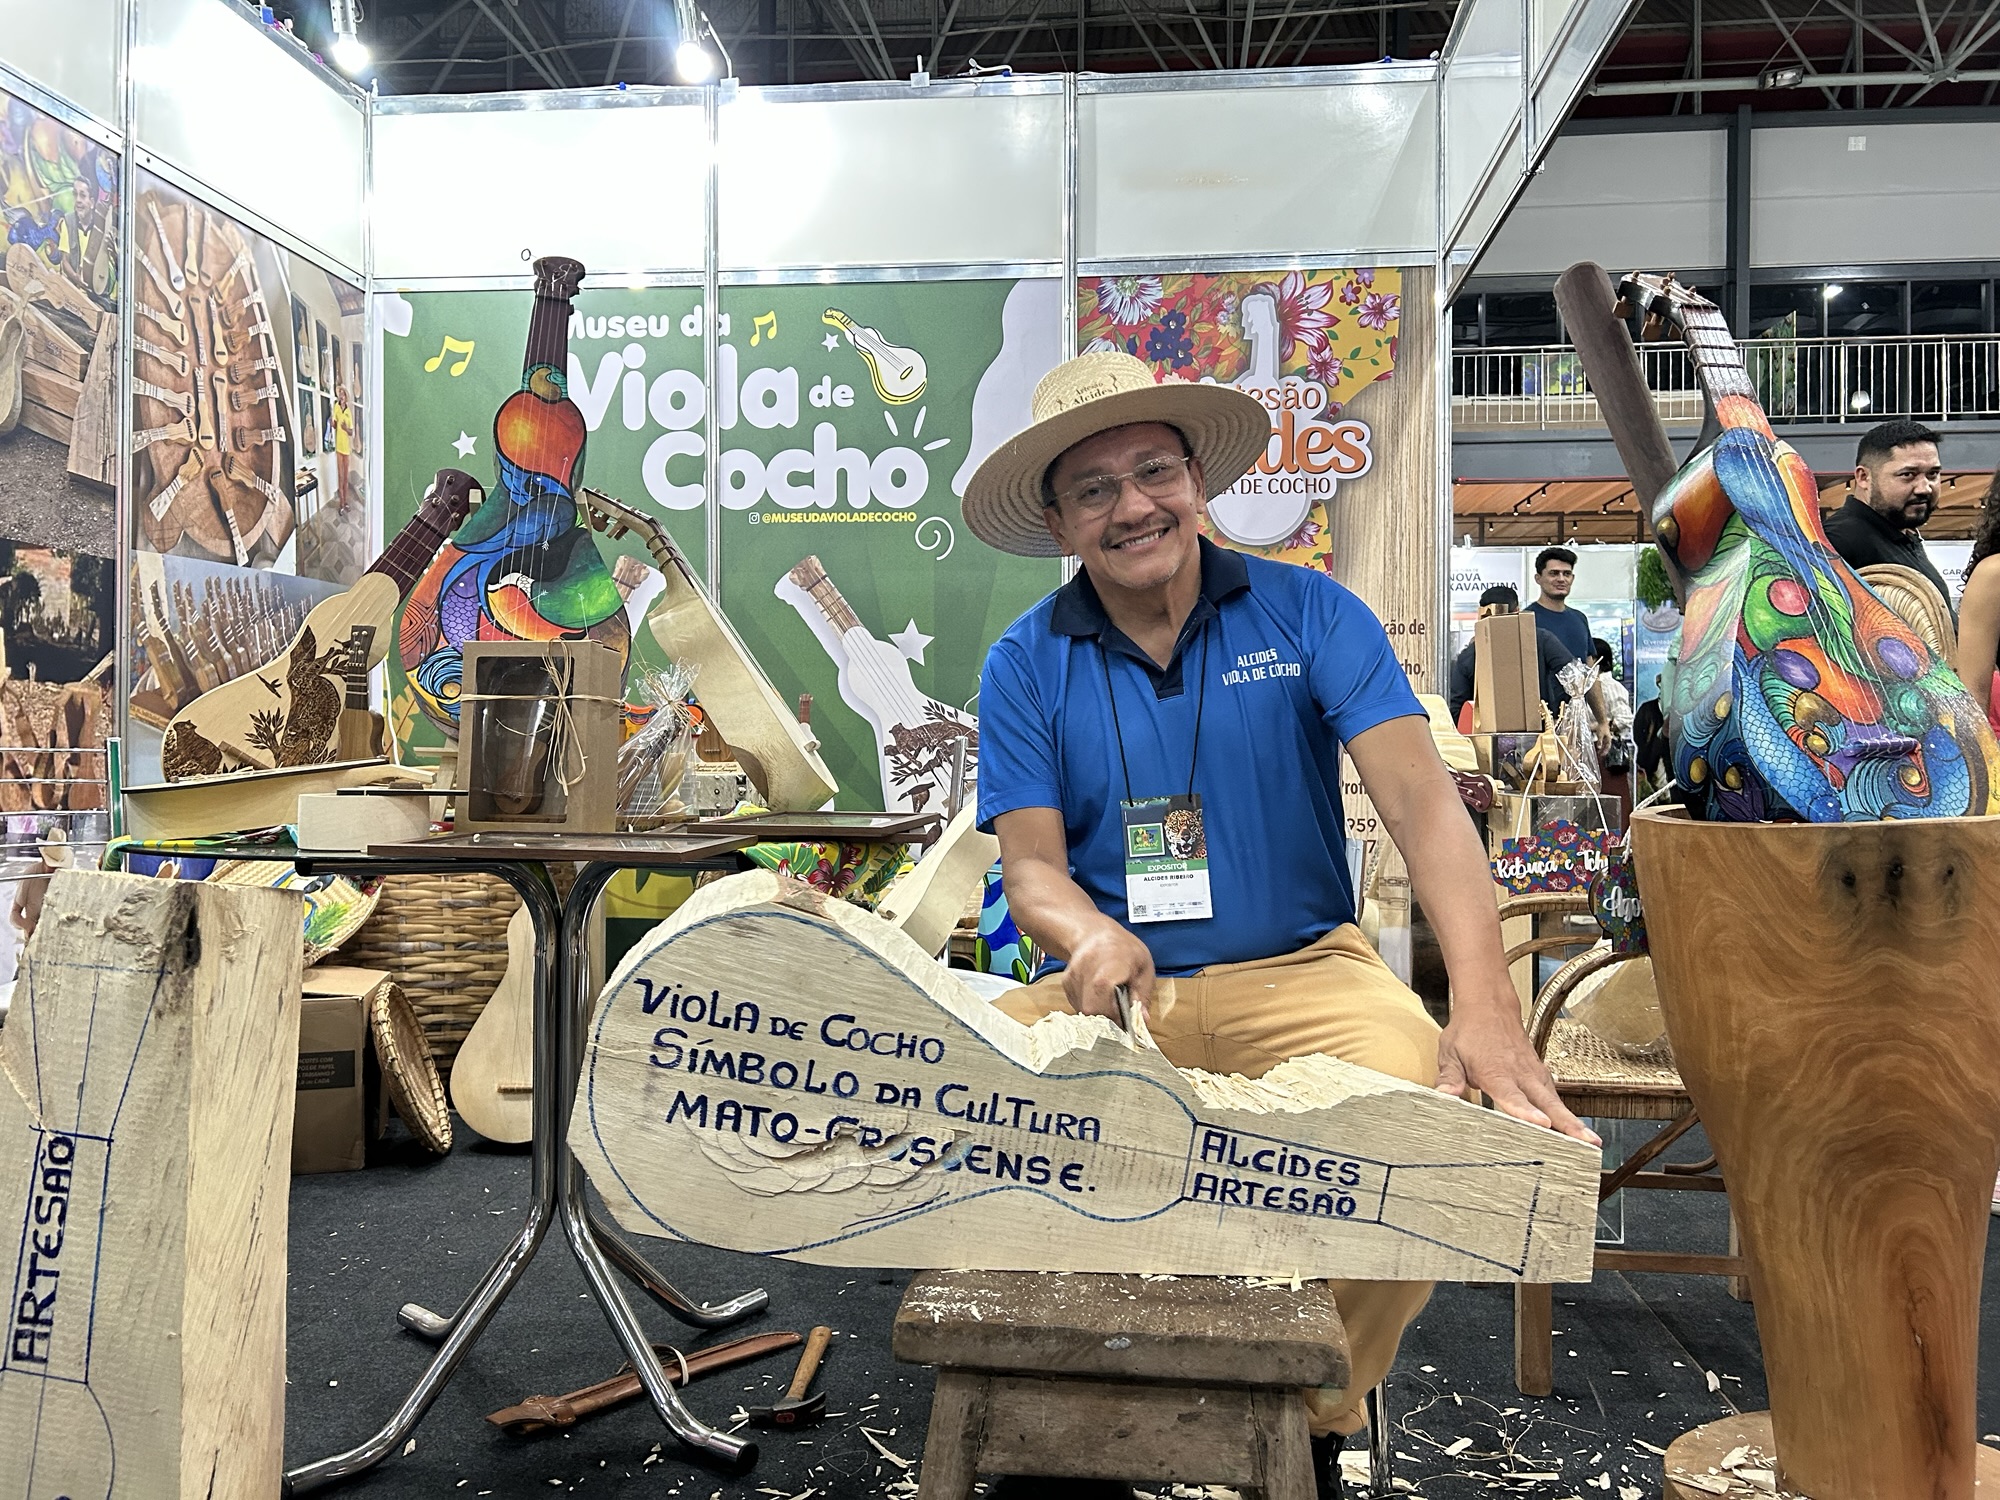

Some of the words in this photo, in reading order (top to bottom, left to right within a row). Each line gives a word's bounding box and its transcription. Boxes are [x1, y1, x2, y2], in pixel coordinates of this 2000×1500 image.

[568, 309, 670, 339] Museu
[567, 342, 799, 431] Viola
[809, 374, 855, 408] de
[1073, 388, 1113, 405] Alcides
[1236, 381, 1321, 410] esão
[1247, 410, 1367, 474] des
[641, 421, 929, 511] Cocho
[1240, 478, 1262, 495] DE
[1267, 477, 1331, 495] COCHO
[762, 511, 917, 524] @MUSEUDAVIOLADECOCHO
[1943, 568, 1963, 576] GAR
[1409, 618, 1425, 635] de
[1237, 648, 1278, 668] ALCIDES
[1401, 659, 1425, 678] ho,
[1222, 670, 1251, 686] VIOLA
[1252, 666, 1267, 681] DE
[1269, 663, 1301, 678] COCHO
[1366, 840, 1377, 854] 7
[1147, 861, 1187, 871] EXPOSITOR
[1496, 857, 1558, 880] Rebuça
[1564, 858, 1574, 871] e
[769, 1016, 808, 1041] DE
[820, 1013, 945, 1064] COCHO
[874, 1082, 922, 1109] DA
[1192, 1172, 1357, 1217] ARTESÃO
[11, 1136, 75, 1364] ARTESÃO
